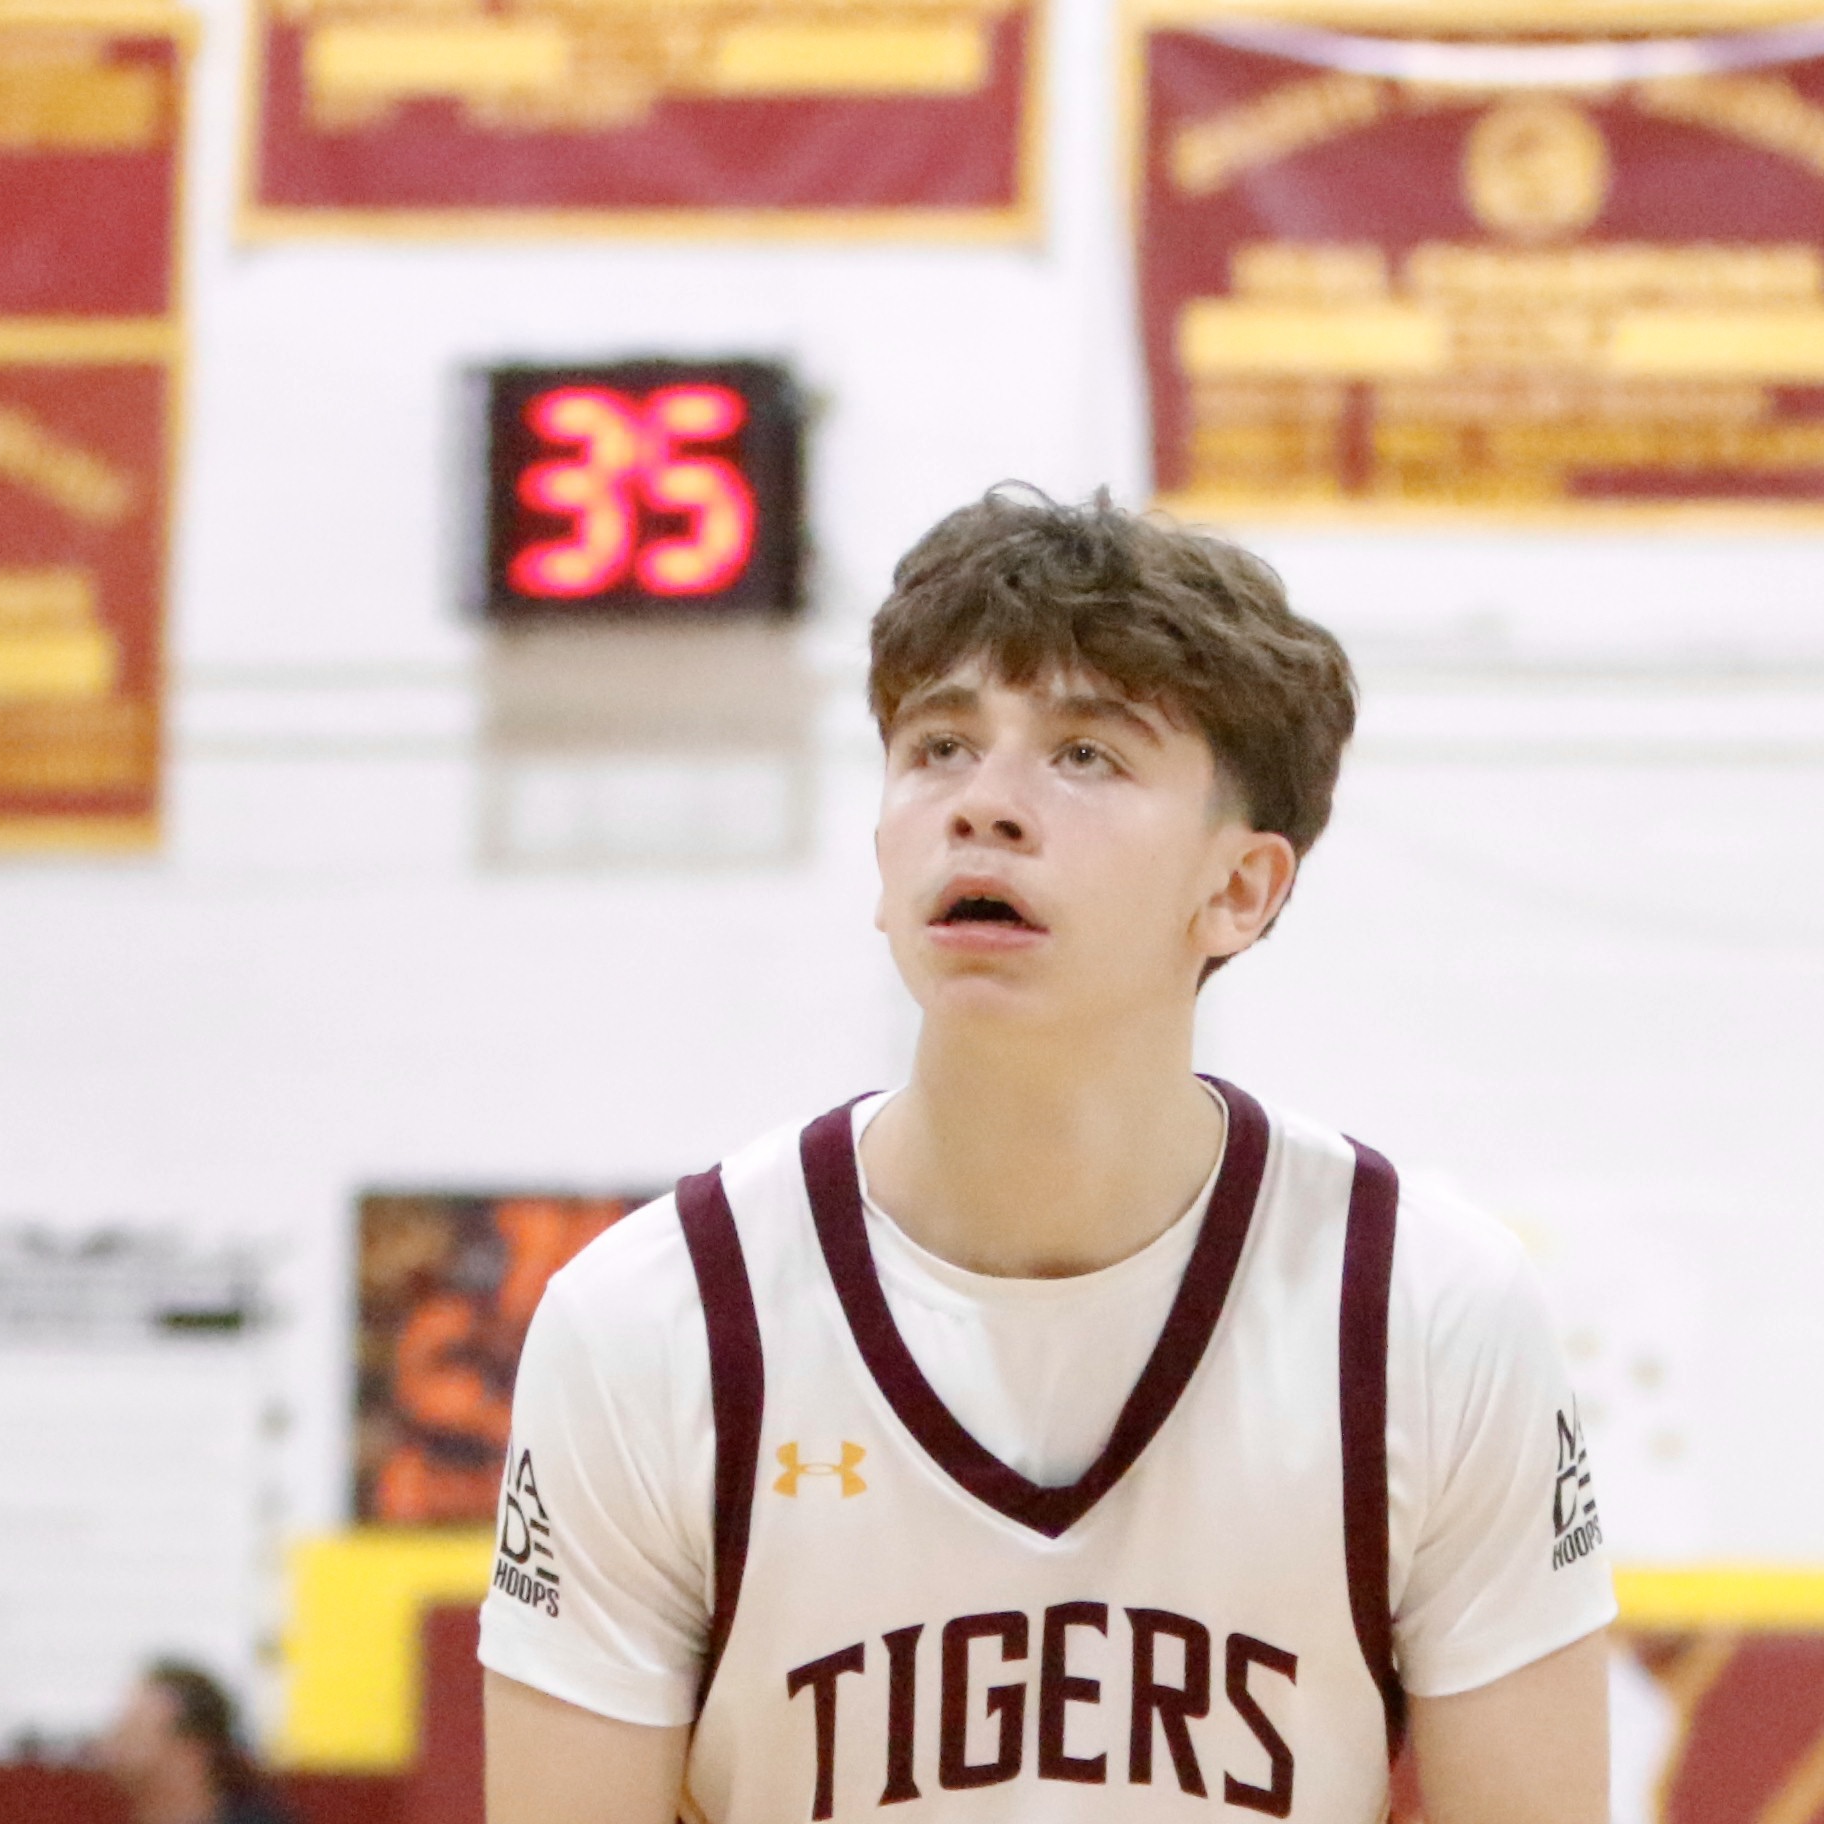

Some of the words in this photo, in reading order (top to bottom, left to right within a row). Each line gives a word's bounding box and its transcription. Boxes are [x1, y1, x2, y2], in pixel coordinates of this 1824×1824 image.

[510, 384, 756, 600] 35
[494, 1558, 560, 1618] HOOPS
[1553, 1515, 1604, 1570] HOOPS
[786, 1601, 1298, 1820] TIGERS
